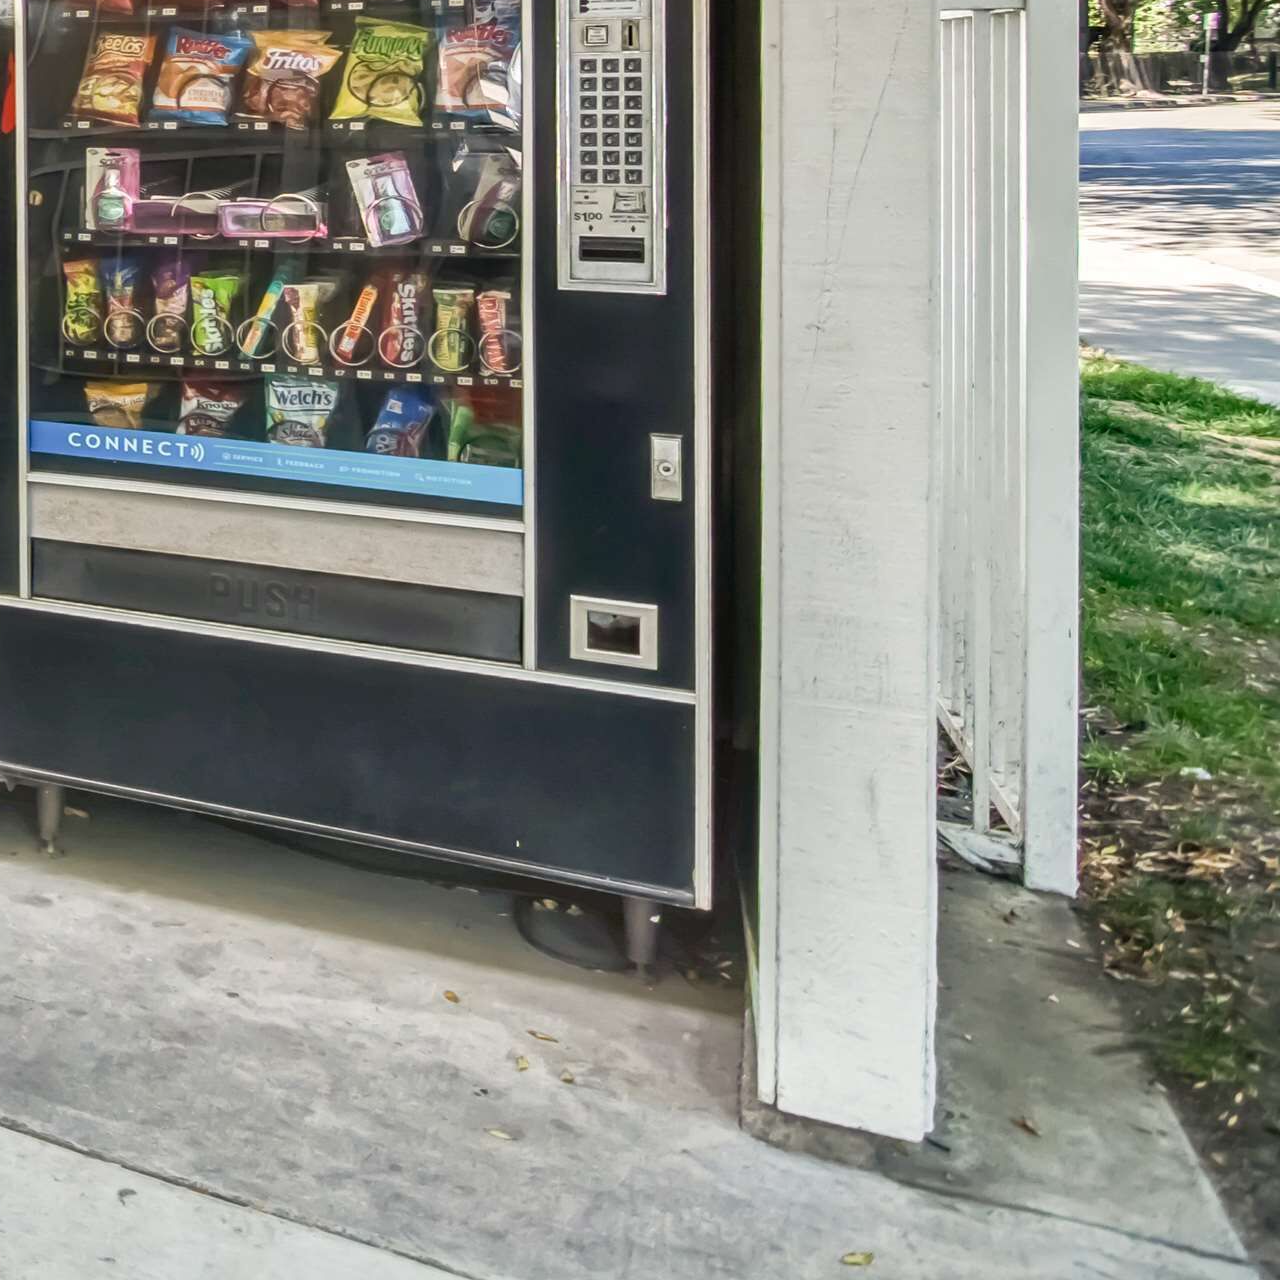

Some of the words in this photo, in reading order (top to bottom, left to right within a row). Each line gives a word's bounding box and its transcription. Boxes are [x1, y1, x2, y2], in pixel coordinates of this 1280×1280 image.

[95, 35, 146, 58] heetos
[264, 48, 321, 71] Fritos
[200, 288, 224, 353] Skittles
[398, 282, 418, 362] Skittles
[276, 389, 333, 407] Welch's
[68, 432, 189, 458] CONNECT
[210, 572, 318, 617] PUSH
